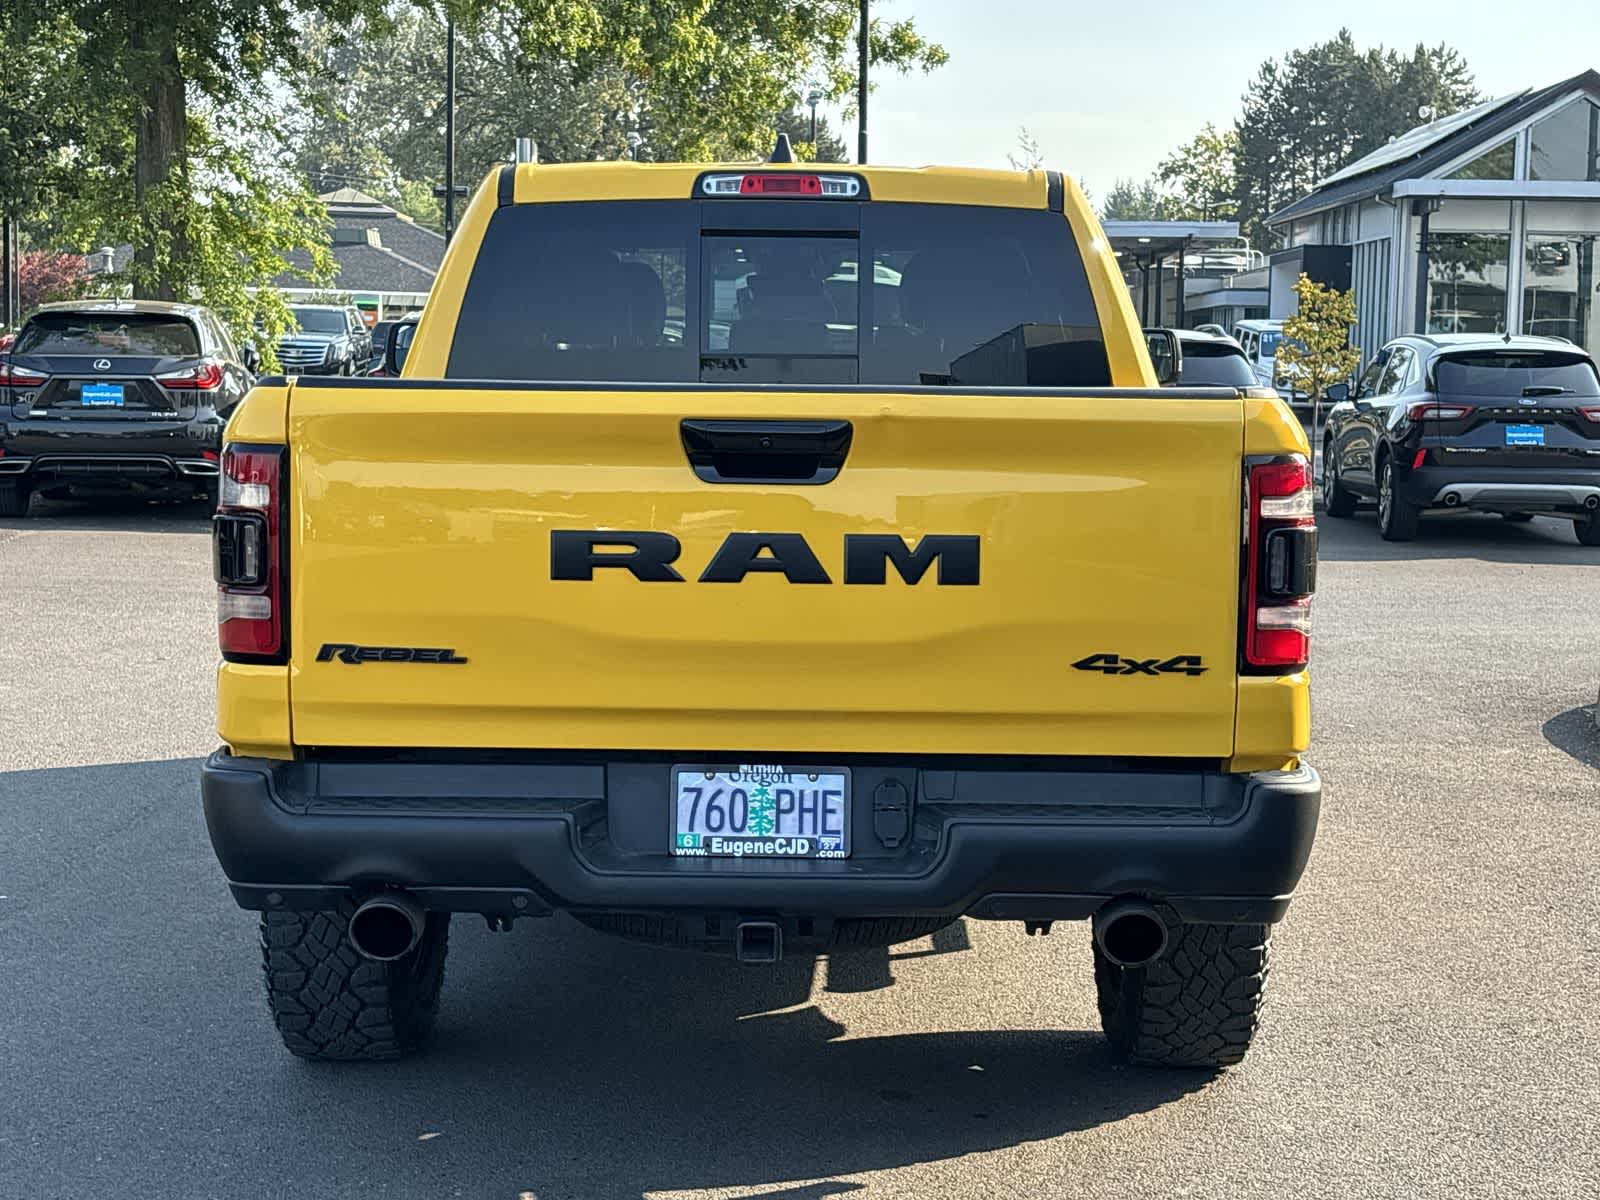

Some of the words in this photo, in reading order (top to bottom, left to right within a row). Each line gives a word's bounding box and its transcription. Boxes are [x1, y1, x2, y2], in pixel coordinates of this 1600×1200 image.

[550, 529, 981, 585] RAM
[315, 643, 469, 665] REBEL
[1070, 653, 1210, 676] 4x4
[729, 771, 794, 788] Oregon
[682, 786, 749, 833] 760
[774, 788, 842, 835] PHE
[675, 847, 708, 856] www.
[711, 837, 810, 856] EugeneCJD
[815, 849, 846, 859] .com
[682, 834, 694, 848] 6
